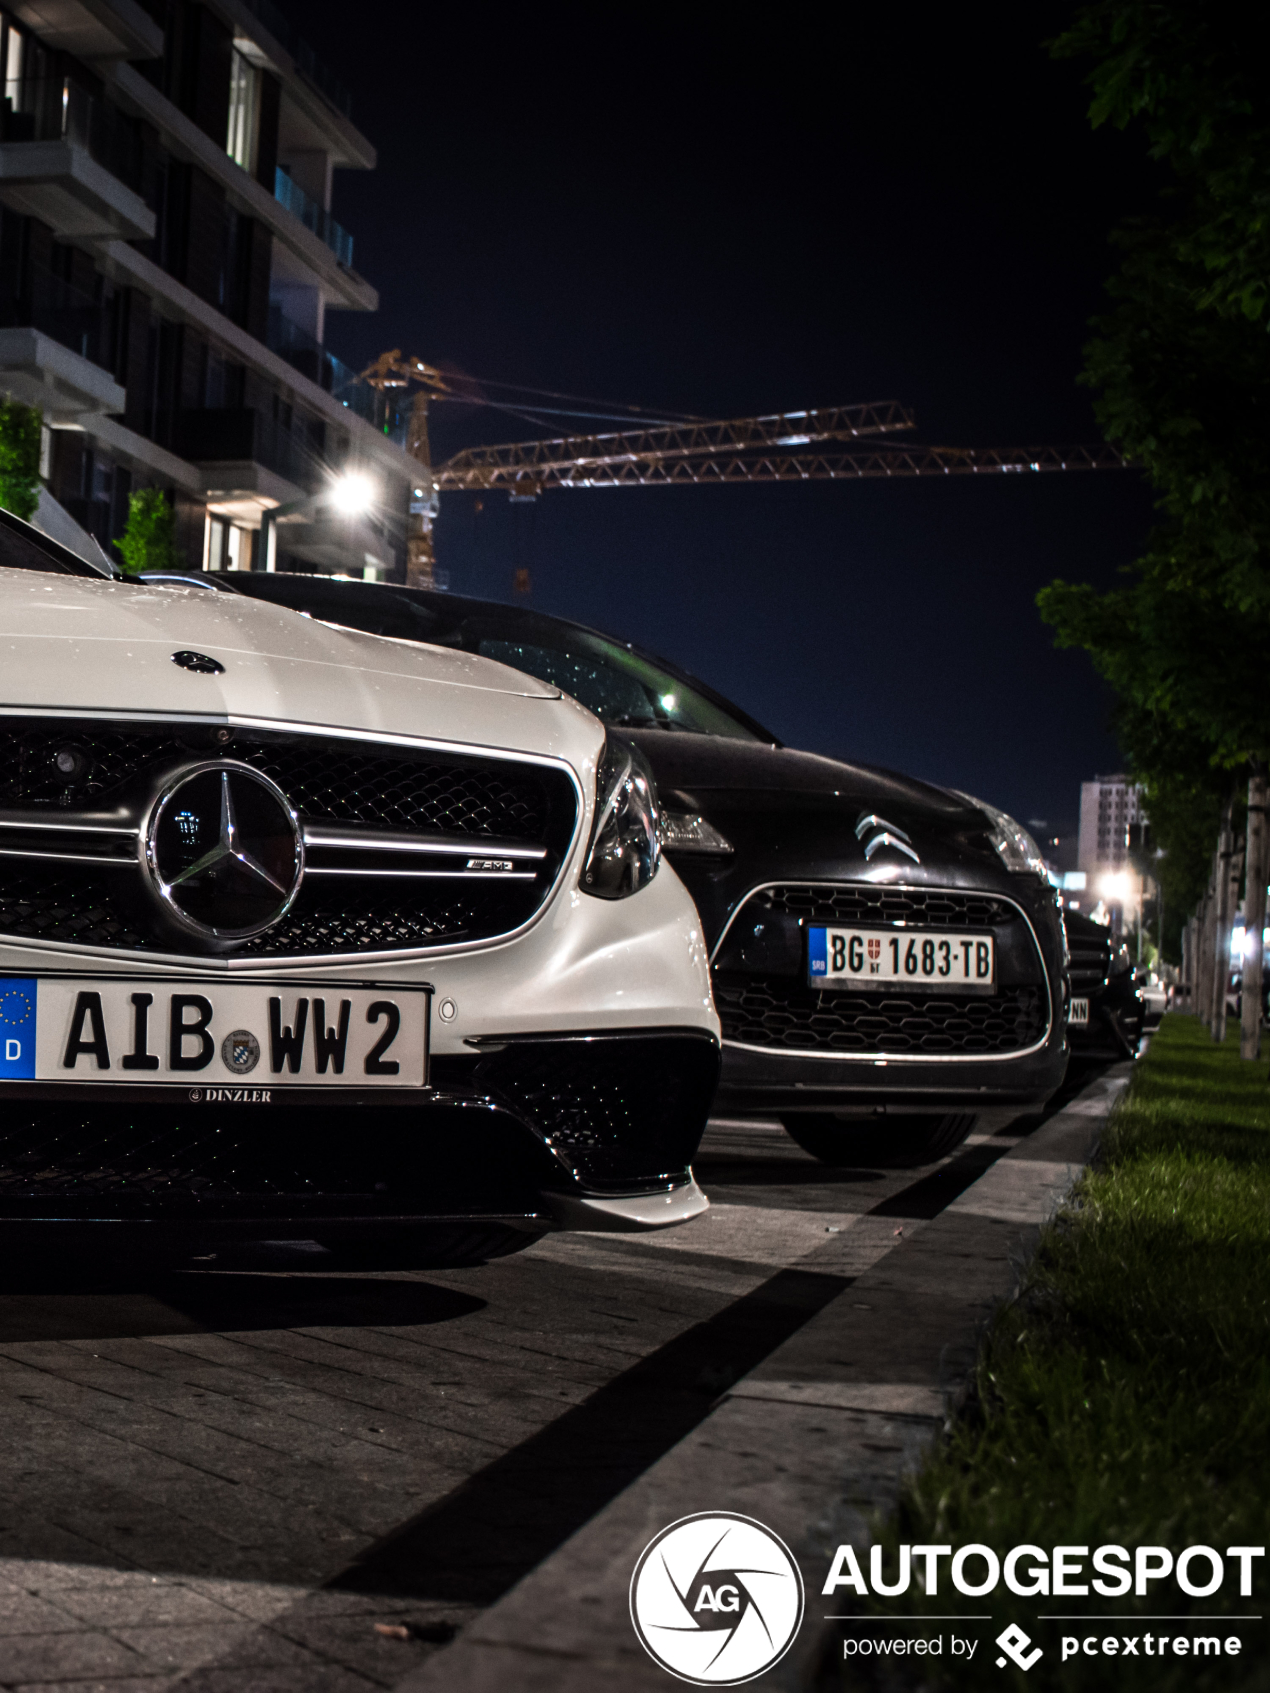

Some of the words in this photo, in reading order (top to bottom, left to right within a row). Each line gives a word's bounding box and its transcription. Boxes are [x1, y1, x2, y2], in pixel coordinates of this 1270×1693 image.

[831, 934, 864, 972] BG
[812, 960, 826, 971] SRB
[63, 991, 216, 1071] AIB
[5, 1039, 22, 1061] D
[206, 1089, 271, 1102] DINZLER
